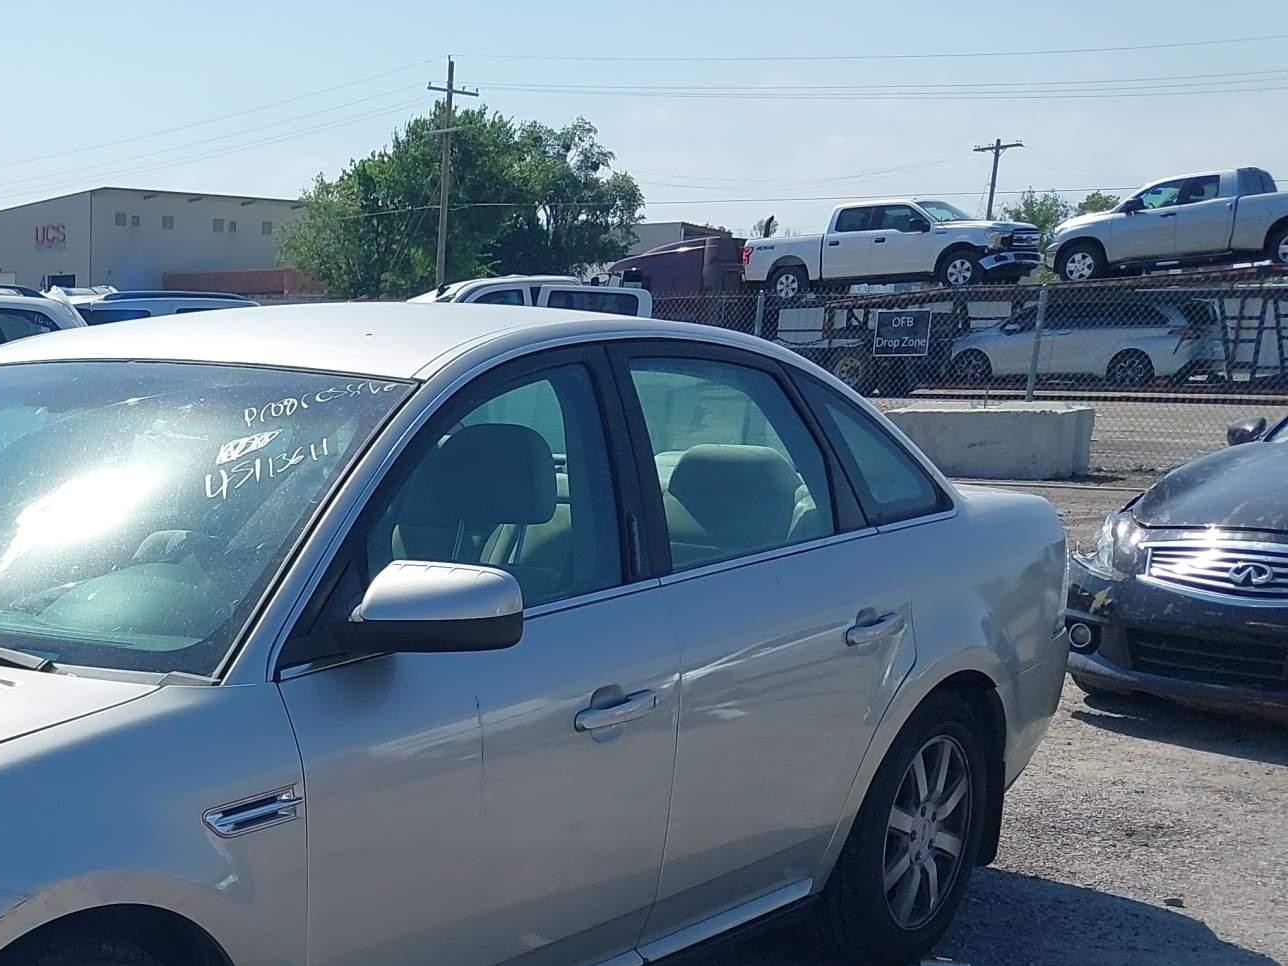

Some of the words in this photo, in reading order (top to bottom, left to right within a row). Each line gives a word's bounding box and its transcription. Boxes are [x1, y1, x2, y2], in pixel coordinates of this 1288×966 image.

[35, 223, 66, 245] UCS
[892, 316, 914, 328] OFB
[875, 337, 900, 350] Drop
[901, 337, 926, 347] Zone
[204, 437, 329, 500] 45113611
